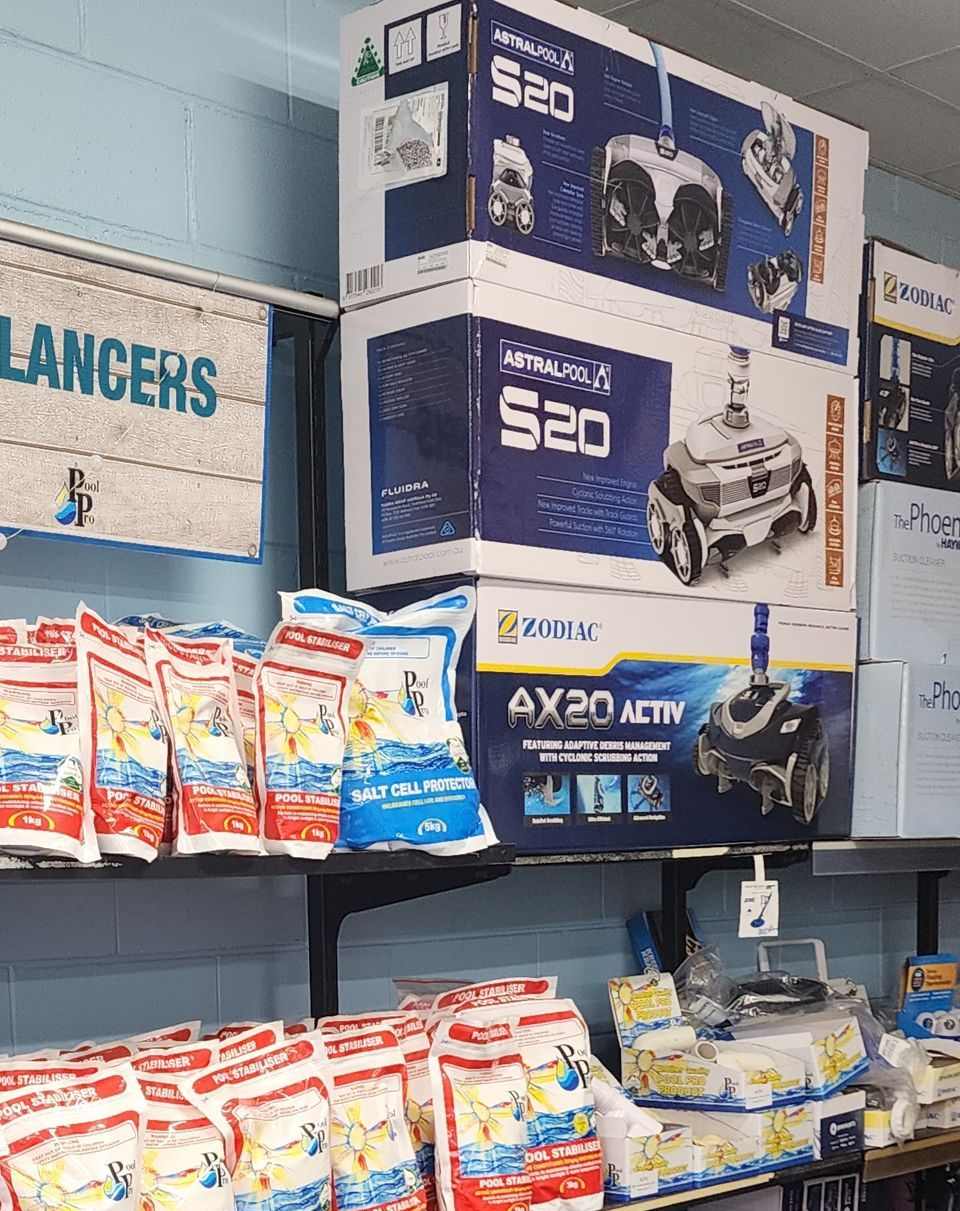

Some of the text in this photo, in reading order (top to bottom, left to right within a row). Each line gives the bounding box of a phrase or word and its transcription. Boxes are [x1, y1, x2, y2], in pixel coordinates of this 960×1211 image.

[494, 28, 560, 65] ASTRALPOOL
[491, 54, 574, 123] S20
[899, 282, 952, 315] ZODIAC
[503, 349, 591, 384] ASTRALPOOL
[499, 386, 610, 458] S20
[67, 467, 100, 502] Pool
[381, 480, 429, 497] FLUIDRA
[75, 493, 95, 527] Pro
[522, 618, 599, 642] ZODIAC
[307, 634, 351, 652] STABILISER
[403, 670, 430, 691] Pool
[508, 687, 614, 730] AX20
[522, 740, 671, 751] FEATURING ADAPTIVE DEBRIS MANAGEMENT
[539, 752, 658, 763] WITH CYCLONIC SCRUBBING ACTION
[275, 794, 303, 804] POOL
[351, 785, 388, 803] SALT
[391, 780, 423, 797] CELL
[21, 814, 42, 827] 1kg
[423, 820, 441, 832] 5kg
[479, 983, 527, 998] STABILISER
[479, 1179, 505, 1188] POOL
